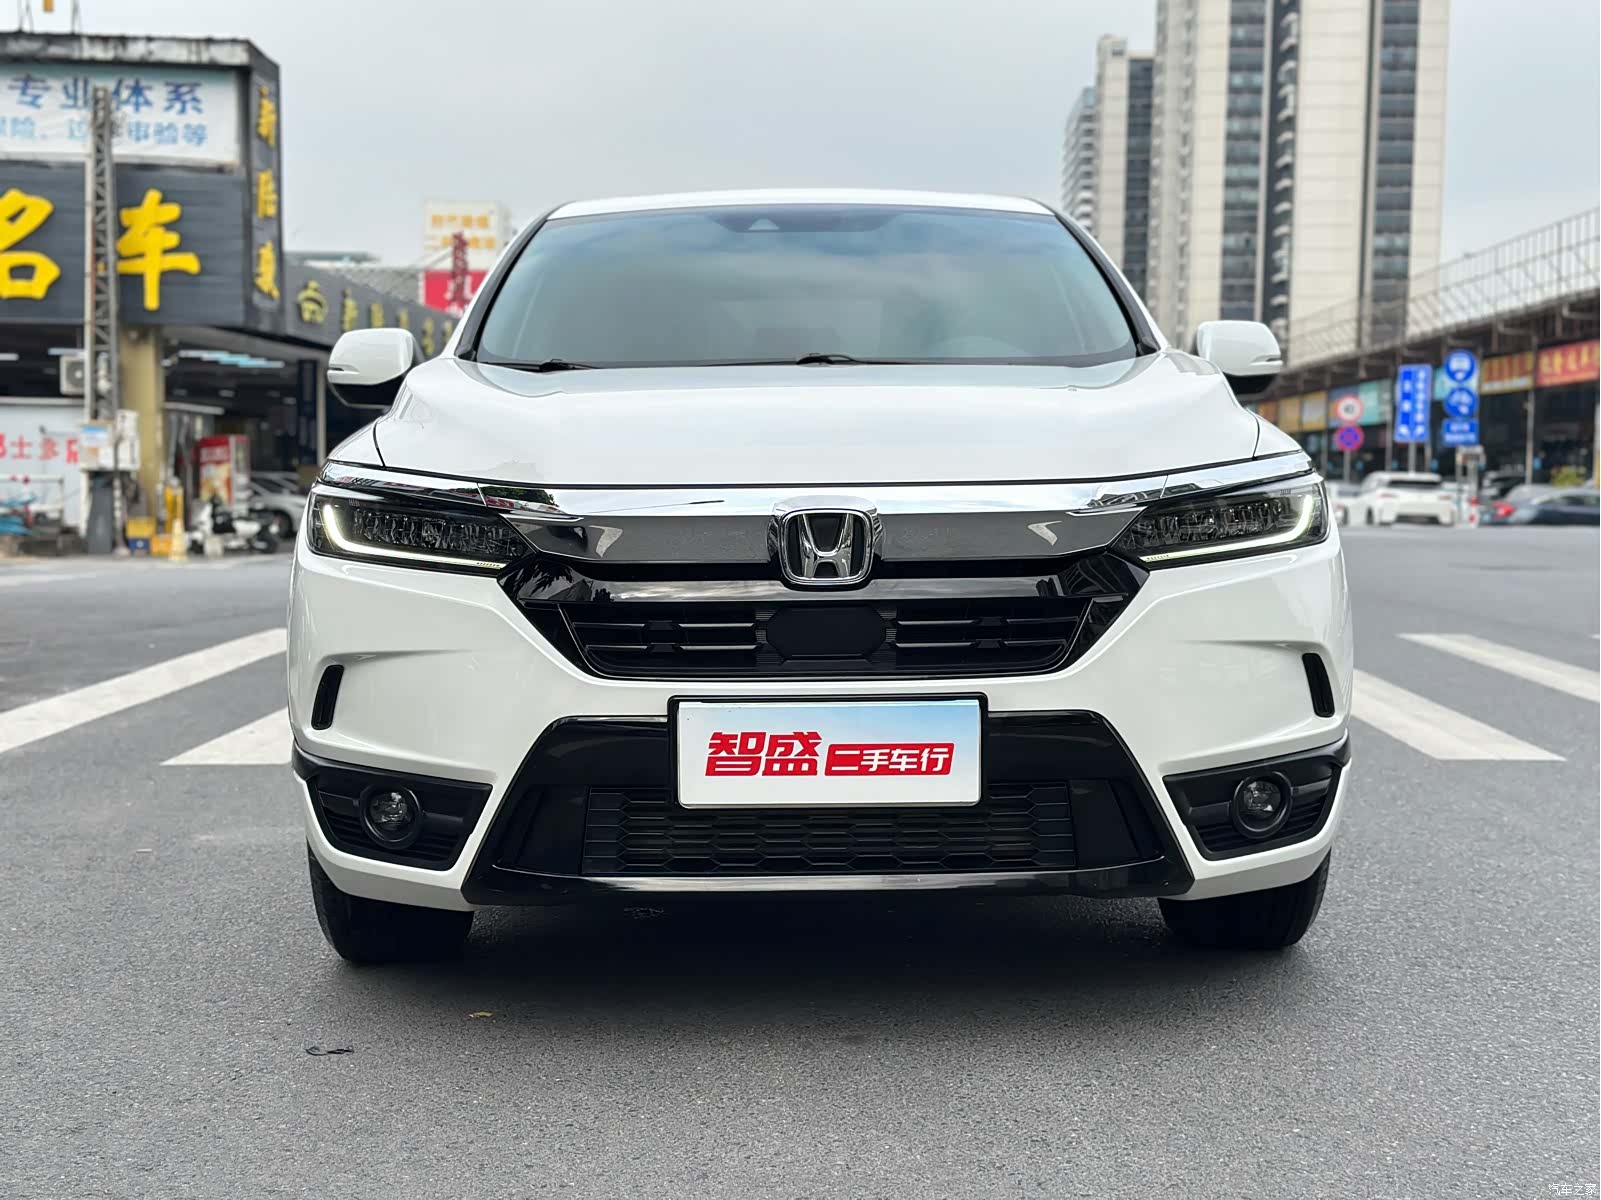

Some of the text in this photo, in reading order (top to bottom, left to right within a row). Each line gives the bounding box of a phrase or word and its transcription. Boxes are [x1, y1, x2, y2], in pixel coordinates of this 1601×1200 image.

[705, 731, 950, 777] 智盛 二手车行
